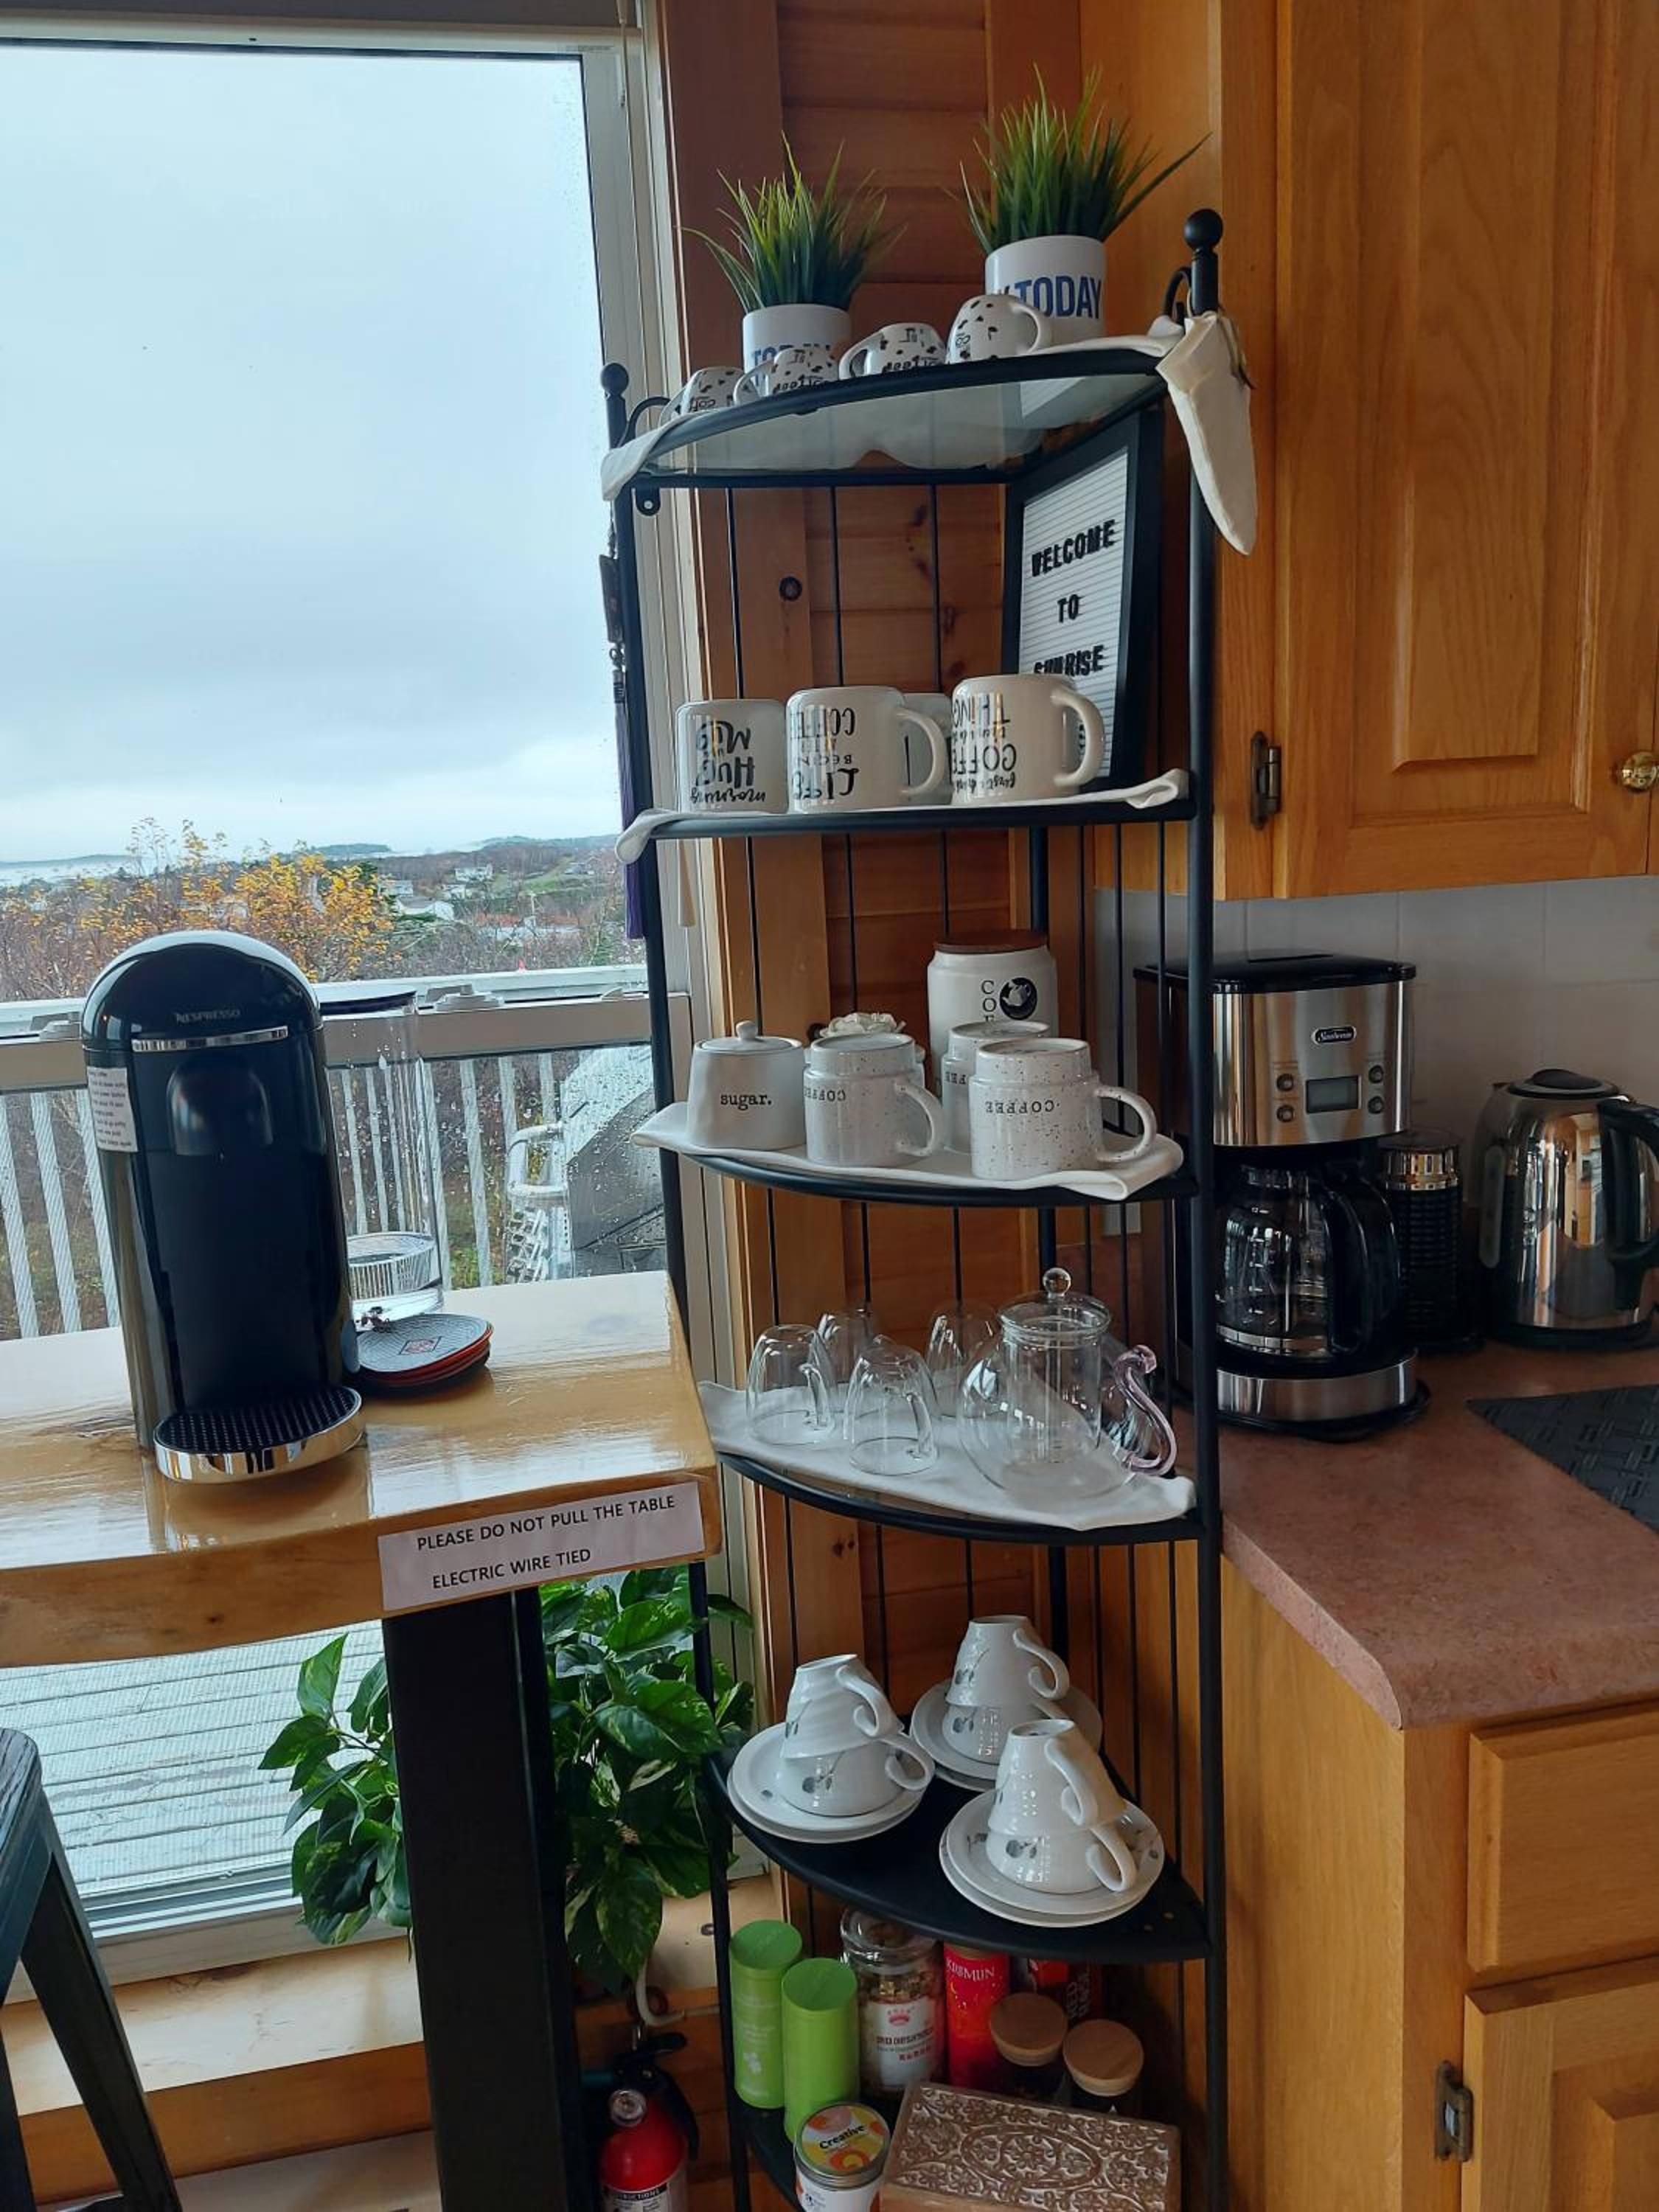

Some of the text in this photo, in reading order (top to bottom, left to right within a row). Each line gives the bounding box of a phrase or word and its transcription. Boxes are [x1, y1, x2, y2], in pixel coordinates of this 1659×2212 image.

[1015, 276, 1102, 319] TODAY
[1032, 519, 1116, 577] WELCOME
[1057, 594, 1079, 623] TO
[720, 1094, 772, 1110] sugar.
[985, 1099, 1055, 1114] COFFEE
[417, 1495, 675, 1551] PLEASE DO NOT PULL THE TABLE
[432, 1549, 591, 1588] ELECTRIC WIRE TIED
[819, 2125, 865, 2149] Creative
